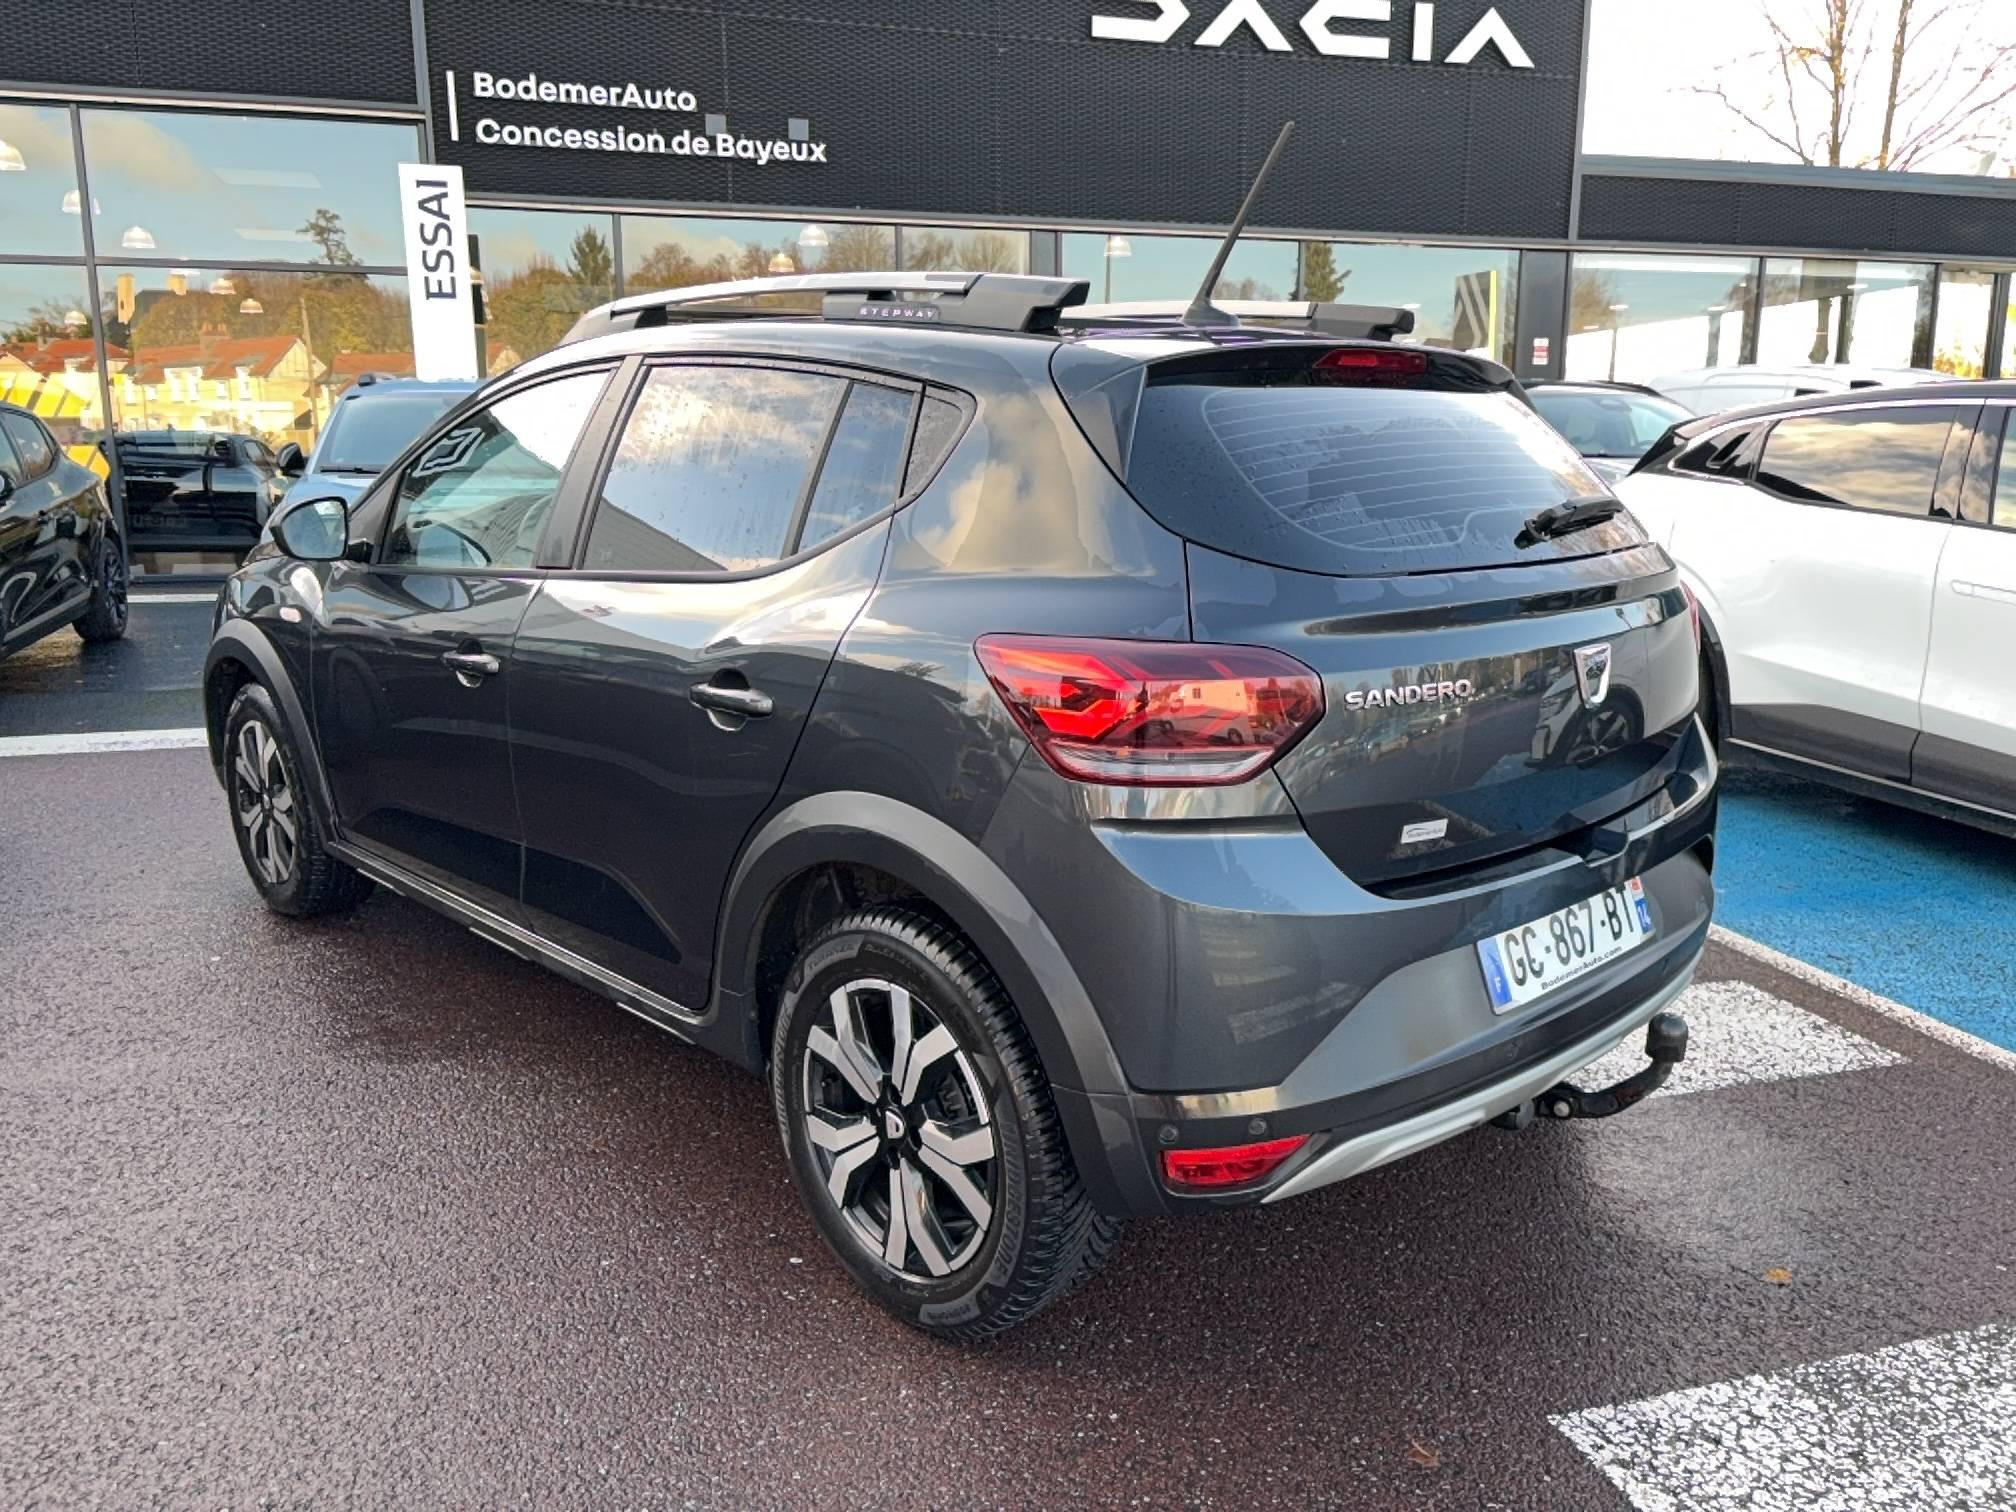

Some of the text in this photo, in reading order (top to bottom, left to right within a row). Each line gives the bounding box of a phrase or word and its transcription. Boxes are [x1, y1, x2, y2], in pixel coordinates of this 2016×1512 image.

[1091, 0, 1535, 69] DACIA
[473, 71, 698, 113] BodemerAuto
[475, 117, 827, 166] Concession de Bayeux
[416, 179, 457, 301] ESSAI
[859, 306, 935, 319] STEPWAY
[1344, 679, 1473, 711] SANDERO
